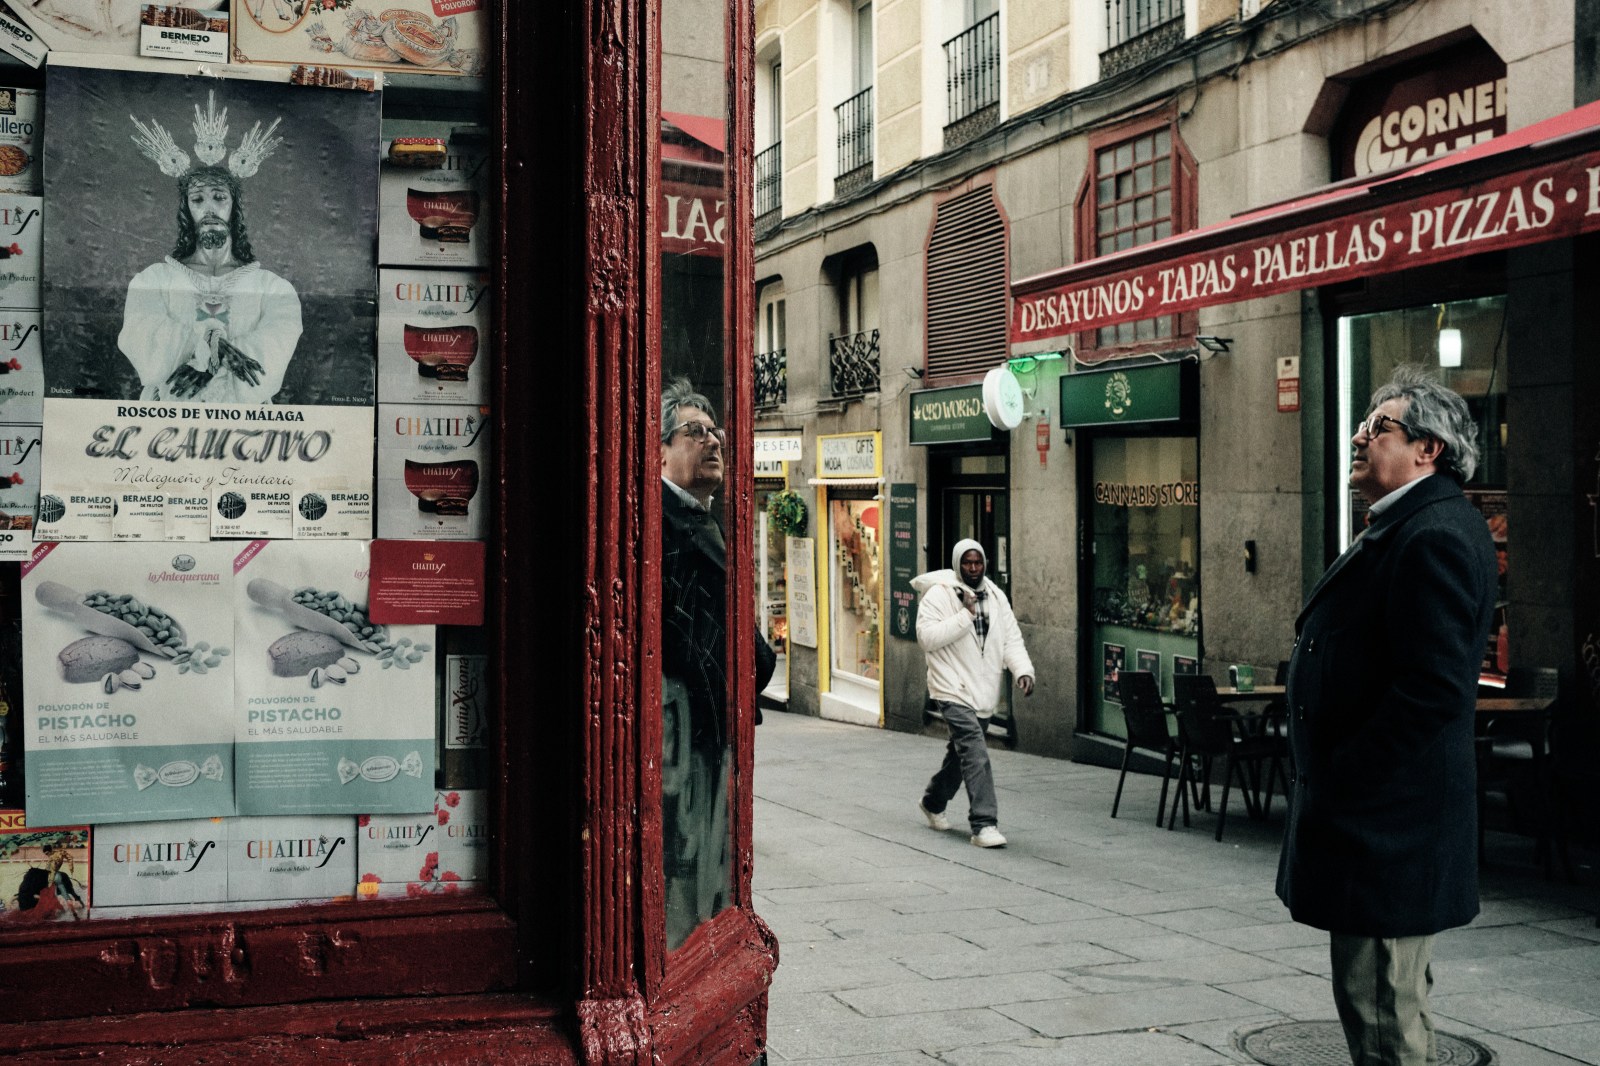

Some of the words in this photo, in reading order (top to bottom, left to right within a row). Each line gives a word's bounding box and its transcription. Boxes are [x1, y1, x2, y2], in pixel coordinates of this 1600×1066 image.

[161, 31, 210, 42] BERMEJO
[1020, 275, 1144, 333] DESAYUNOS
[1158, 254, 1236, 305] TAPAS
[1252, 218, 1386, 287] PAELLAS
[1408, 178, 1554, 254] PIZZAS
[9, 273, 36, 282] Product
[7, 388, 34, 397] Product
[117, 406, 177, 419] ROSCOS
[182, 407, 200, 419] DE
[206, 408, 241, 420] VINO
[245, 407, 304, 421] MÁLAGA
[922, 402, 942, 421] CBD
[942, 398, 980, 420] WORLD
[86, 425, 141, 460] EL
[147, 426, 332, 463] CAUTIVO
[755, 440, 800, 452] PESETA
[856, 439, 874, 454] GIFTS
[824, 458, 842, 470] MODA
[113, 466, 202, 489] Malagueño
[203, 476, 217, 490] y
[219, 467, 296, 486] Trinitario
[123, 495, 163, 503] BERMEJO
[251, 493, 290, 501] BERMEJO
[1095, 480, 1157, 507] CANNABIS
[1160, 481, 1198, 506] STORE
[71, 496, 111, 504] BERMEJO
[236, 543, 260, 567] NOVEDAD
[153, 571, 219, 583] Antequerana
[248, 696, 301, 705] POLVORÓN
[38, 702, 94, 712] POLVORÓN
[97, 702, 110, 710] DE
[248, 707, 342, 723] PISTACHO
[38, 714, 137, 731] PISTACHO
[263, 726, 284, 735] MÁS
[287, 725, 343, 734] SALUDABLE
[38, 735, 50, 743] EL
[79, 732, 139, 741] SALUDABLE
